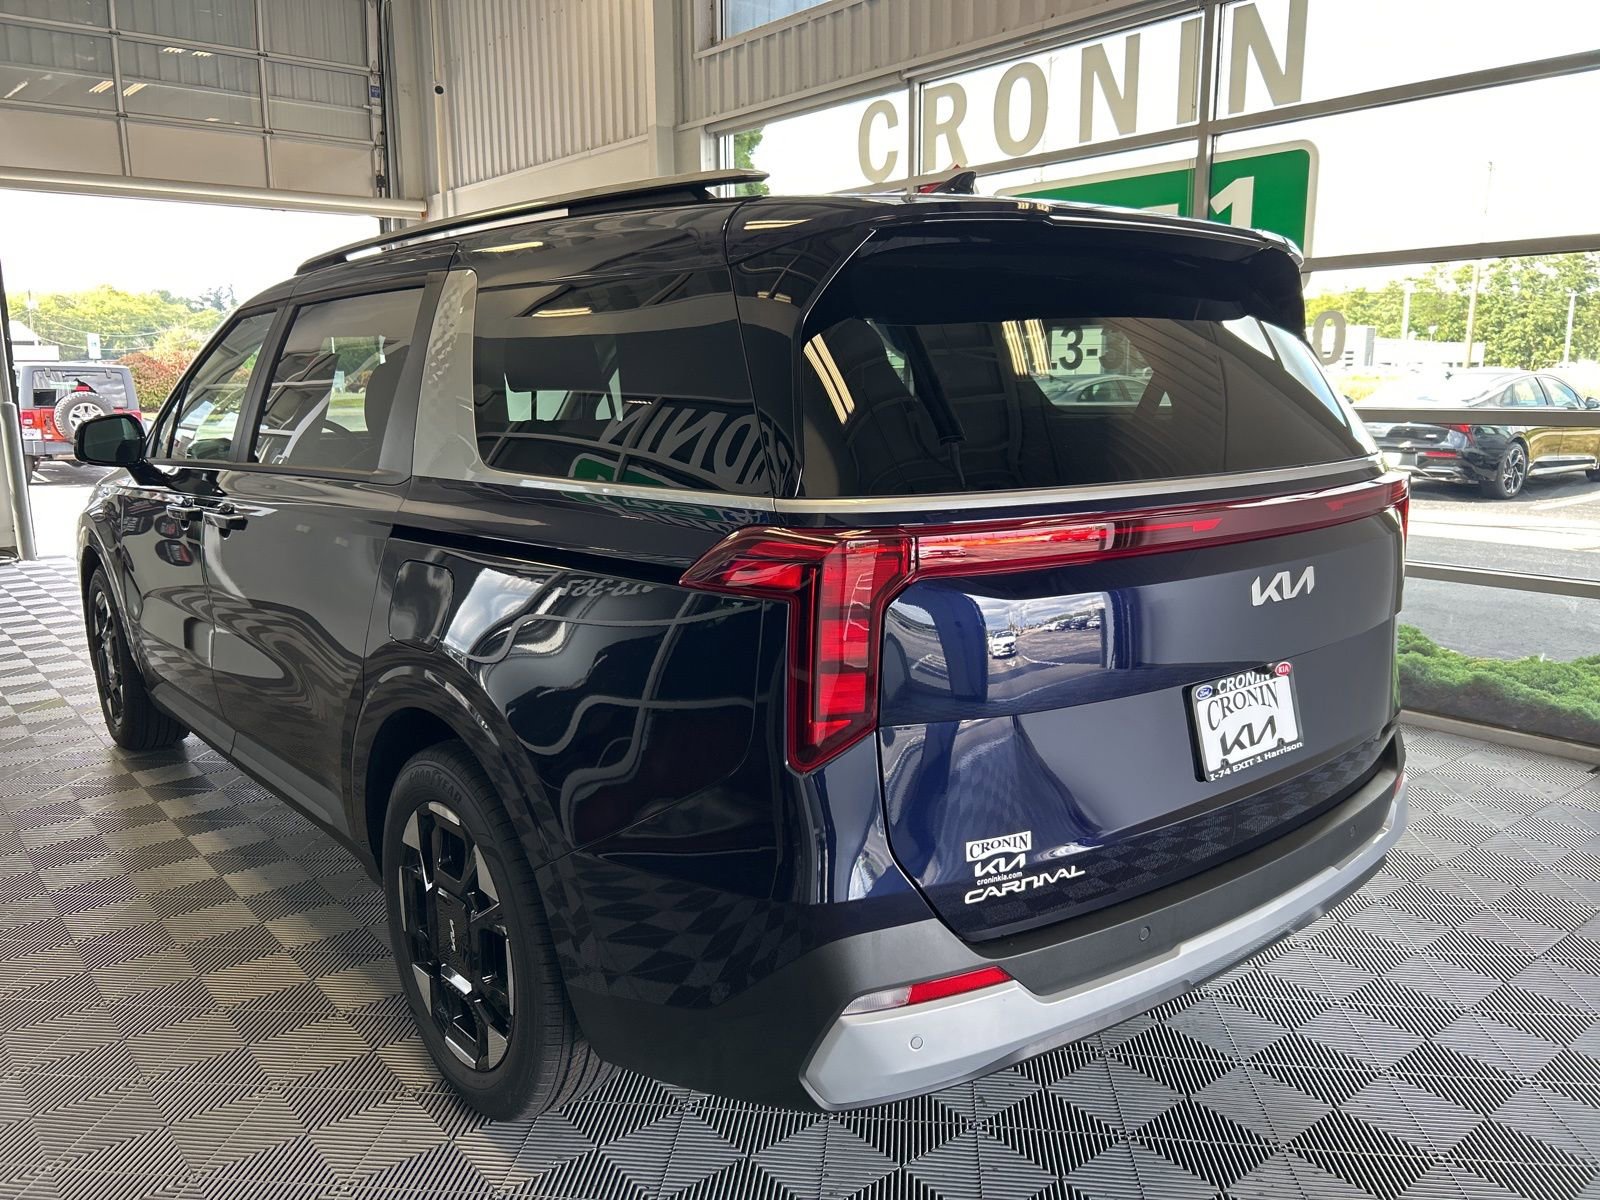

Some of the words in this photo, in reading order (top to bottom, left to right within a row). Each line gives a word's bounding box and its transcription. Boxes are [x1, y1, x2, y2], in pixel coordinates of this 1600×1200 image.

[858, 0, 1308, 184] CRONIN
[1218, 670, 1271, 694] CRONIN
[1278, 664, 1290, 674] KIA
[1208, 681, 1279, 731] CRONIN
[1210, 767, 1231, 782] I-74
[1232, 758, 1254, 772] EXIT
[1256, 754, 1262, 763] 1
[1264, 741, 1304, 760] Harrison
[969, 833, 1029, 859] CRONIN
[964, 865, 1086, 905] CARNIVAL
[976, 871, 1023, 886] croninkia.com
